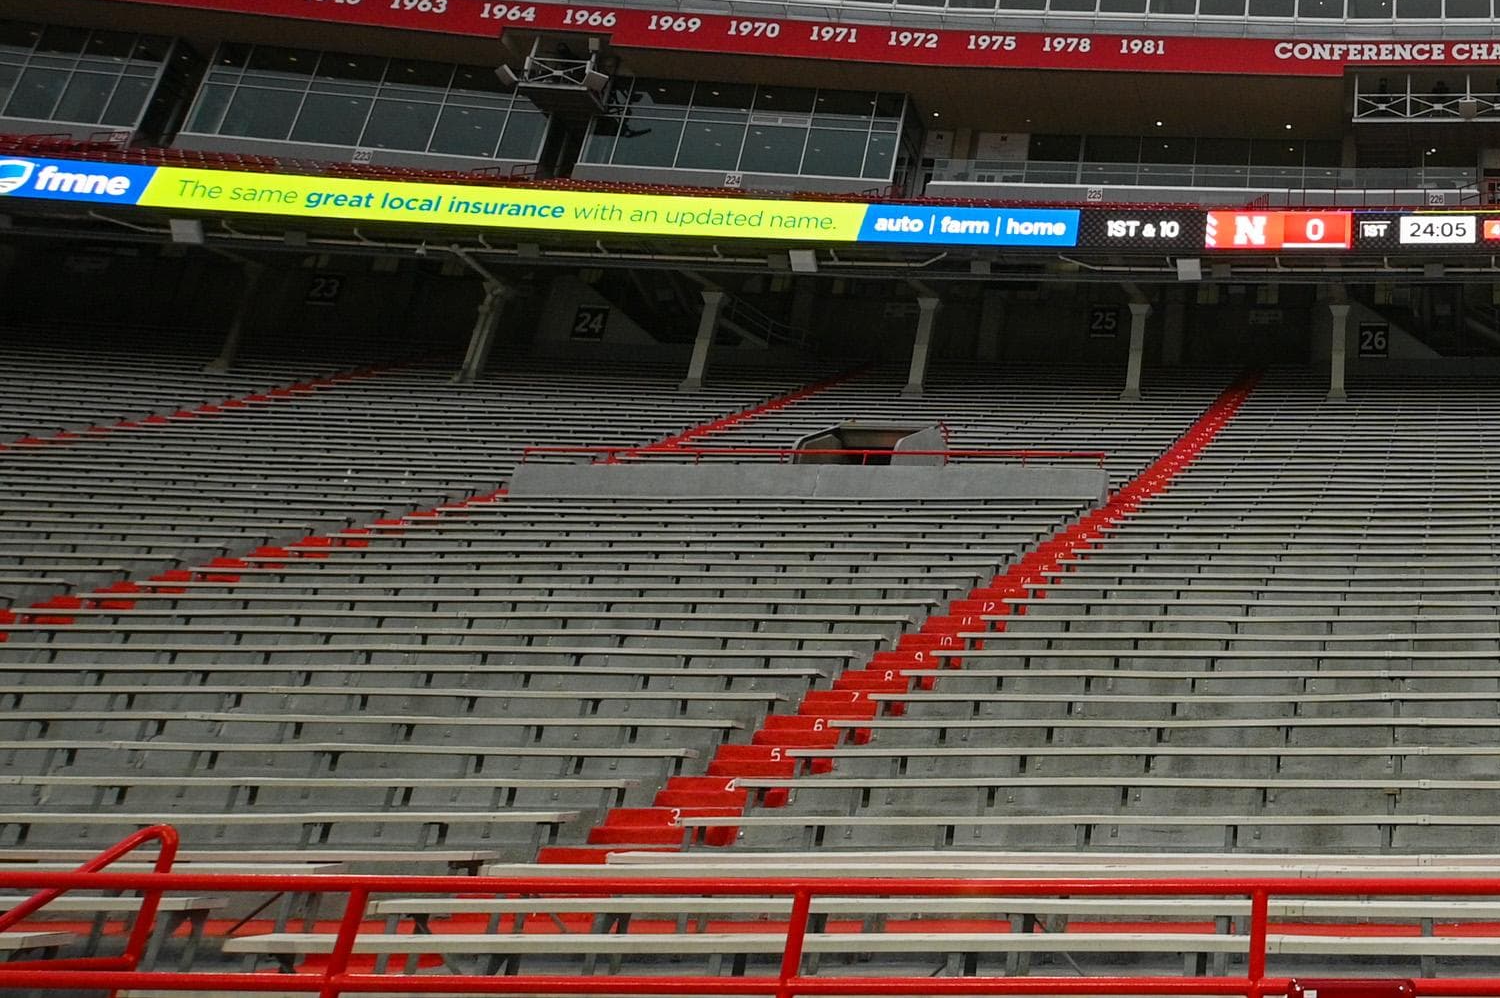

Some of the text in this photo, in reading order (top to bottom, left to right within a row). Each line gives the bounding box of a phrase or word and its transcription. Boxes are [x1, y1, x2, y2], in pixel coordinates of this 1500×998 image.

[480, 3, 536, 22] 1964
[562, 9, 617, 27] 1966
[647, 15, 702, 33] 1969
[727, 20, 780, 38] 1970
[809, 25, 857, 43] 1971
[888, 31, 939, 48] 1972
[967, 34, 1017, 51] 1975
[1042, 37, 1091, 53] 1978
[1119, 39, 1165, 55] 1981
[1274, 42, 1445, 61] CONFERENCE
[36, 165, 131, 196] fmne
[725, 175, 741, 184] 224
[1088, 190, 1102, 199] 225
[1430, 194, 1444, 204] 226
[177, 179, 838, 231] The same great local insurance with an updated name.
[874, 216, 1066, 236] auto farm home
[1107, 220, 1179, 237] 1ST & 10
[1234, 215, 1268, 245] N
[1305, 218, 1325, 241] 0
[1362, 224, 1388, 238] 1ST
[1410, 222, 1467, 238] 24:05
[310, 277, 340, 296] 23
[574, 312, 604, 333] 24
[1091, 312, 1117, 330] 25
[1360, 330, 1386, 350] 26
[962, 617, 972, 626] 11
[914, 651, 924, 662] 9
[850, 691, 860, 703] 7
[813, 718, 825, 731] 6
[770, 748, 781, 762] 5
[725, 779, 736, 792] 4
[667, 808, 681, 826] 3
